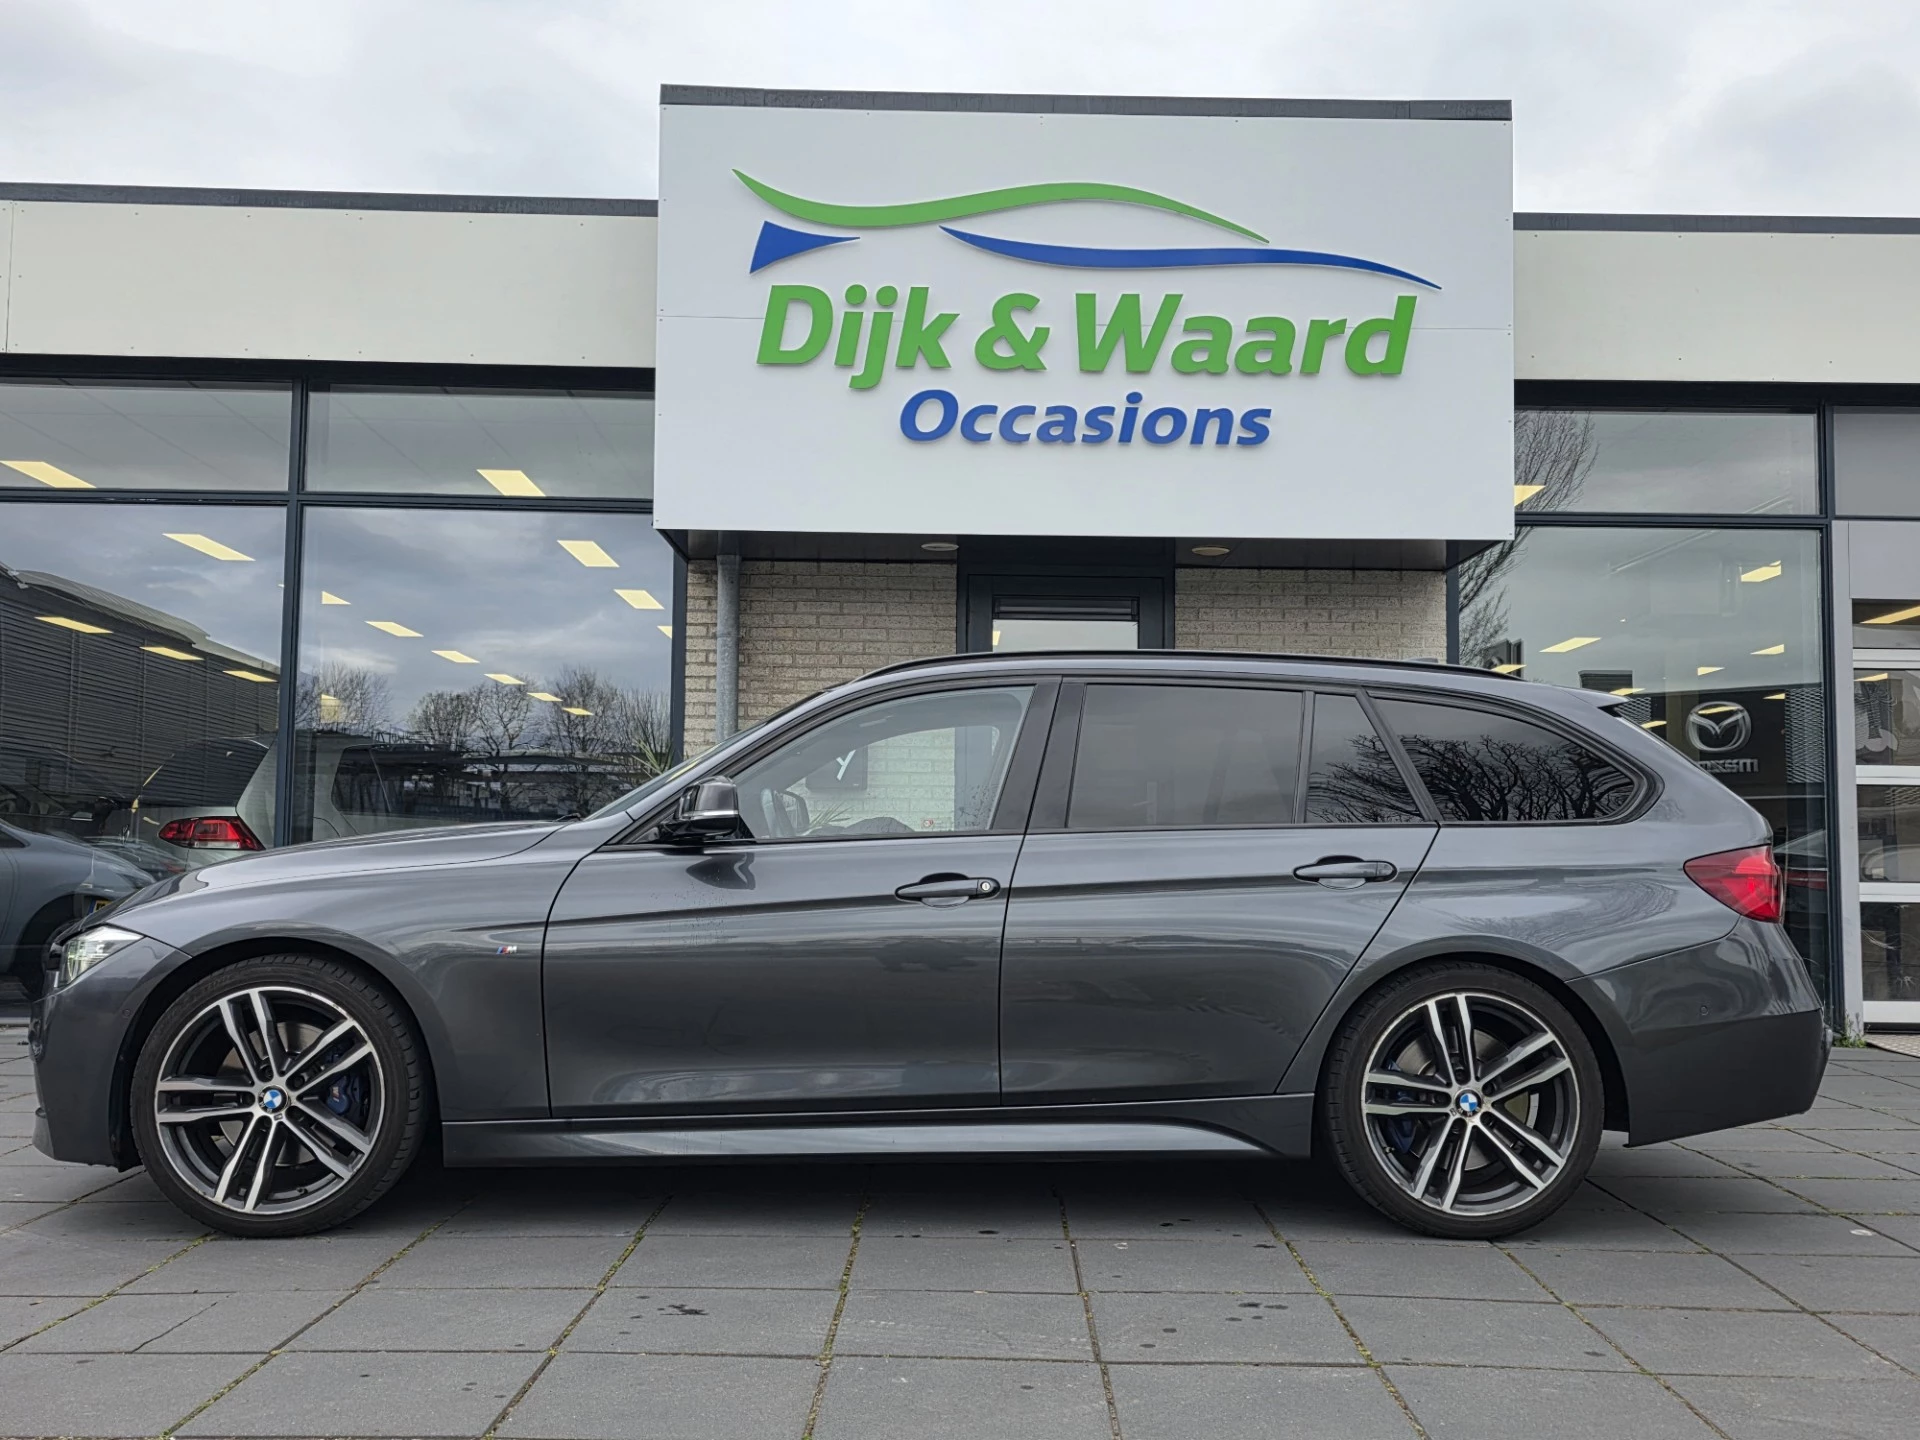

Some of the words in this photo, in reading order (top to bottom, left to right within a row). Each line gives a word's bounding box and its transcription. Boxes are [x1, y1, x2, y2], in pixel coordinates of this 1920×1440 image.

[758, 285, 960, 390] Dijk
[975, 293, 1050, 371] &
[1076, 294, 1418, 375] Waard
[900, 390, 1272, 446] Occasions
